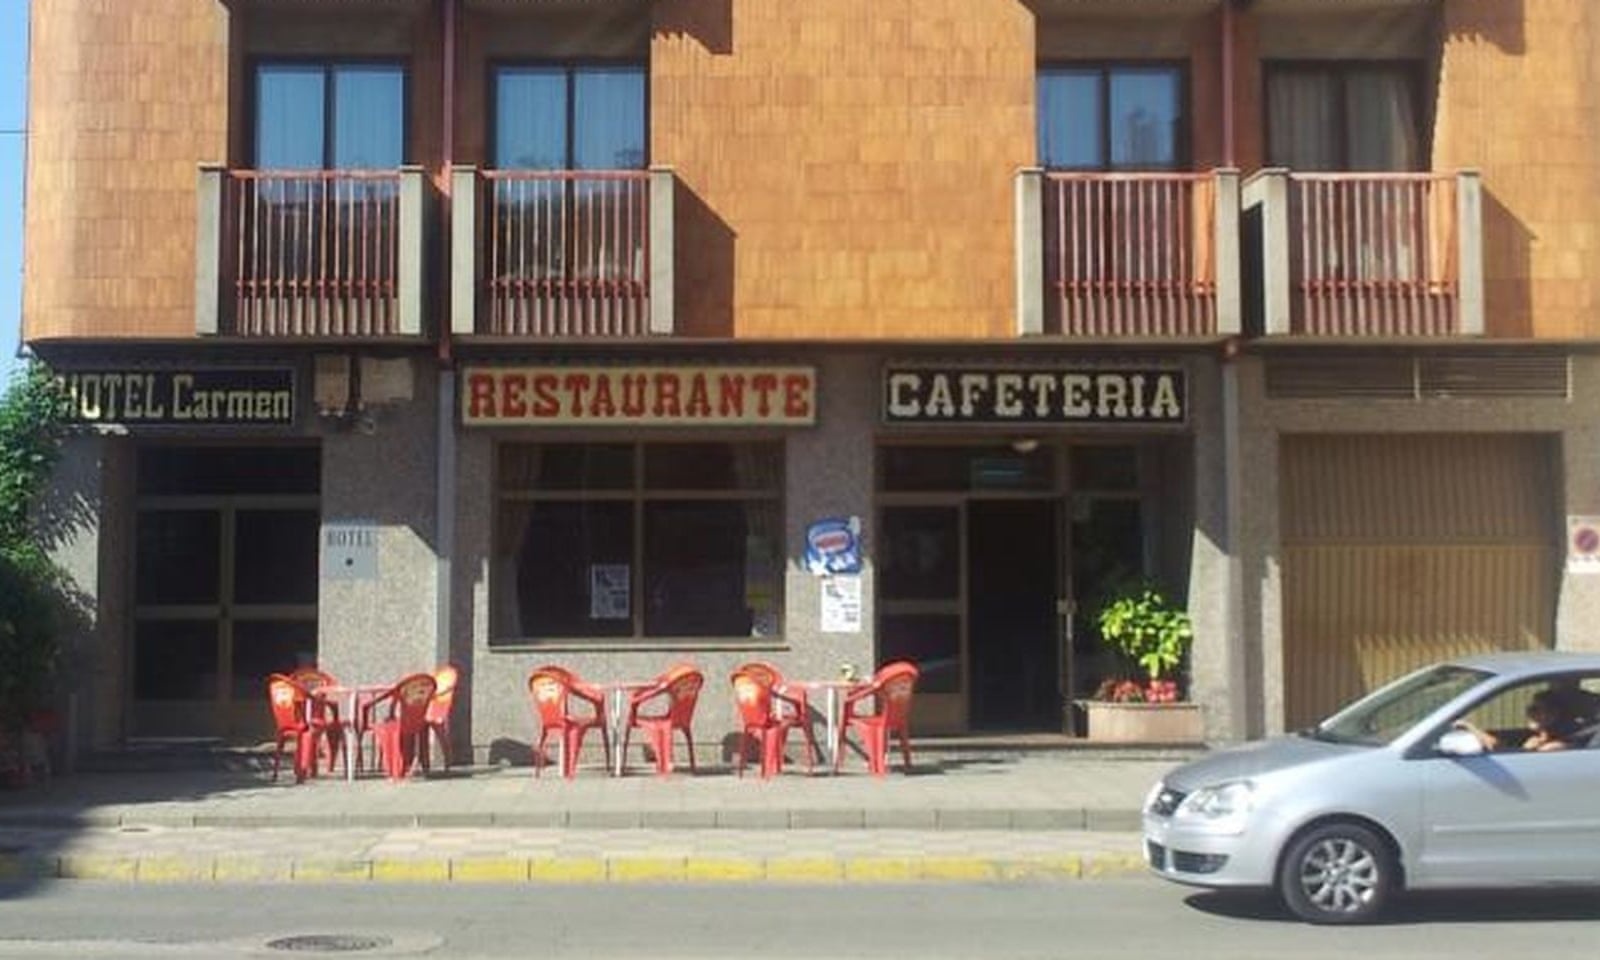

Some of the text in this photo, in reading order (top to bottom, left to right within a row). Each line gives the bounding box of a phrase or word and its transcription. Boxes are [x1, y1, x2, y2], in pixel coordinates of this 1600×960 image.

[56, 373, 289, 419] HOTEL Carmen
[467, 372, 811, 418] RESTAURANTE
[888, 372, 1181, 418] CAFETERIA
